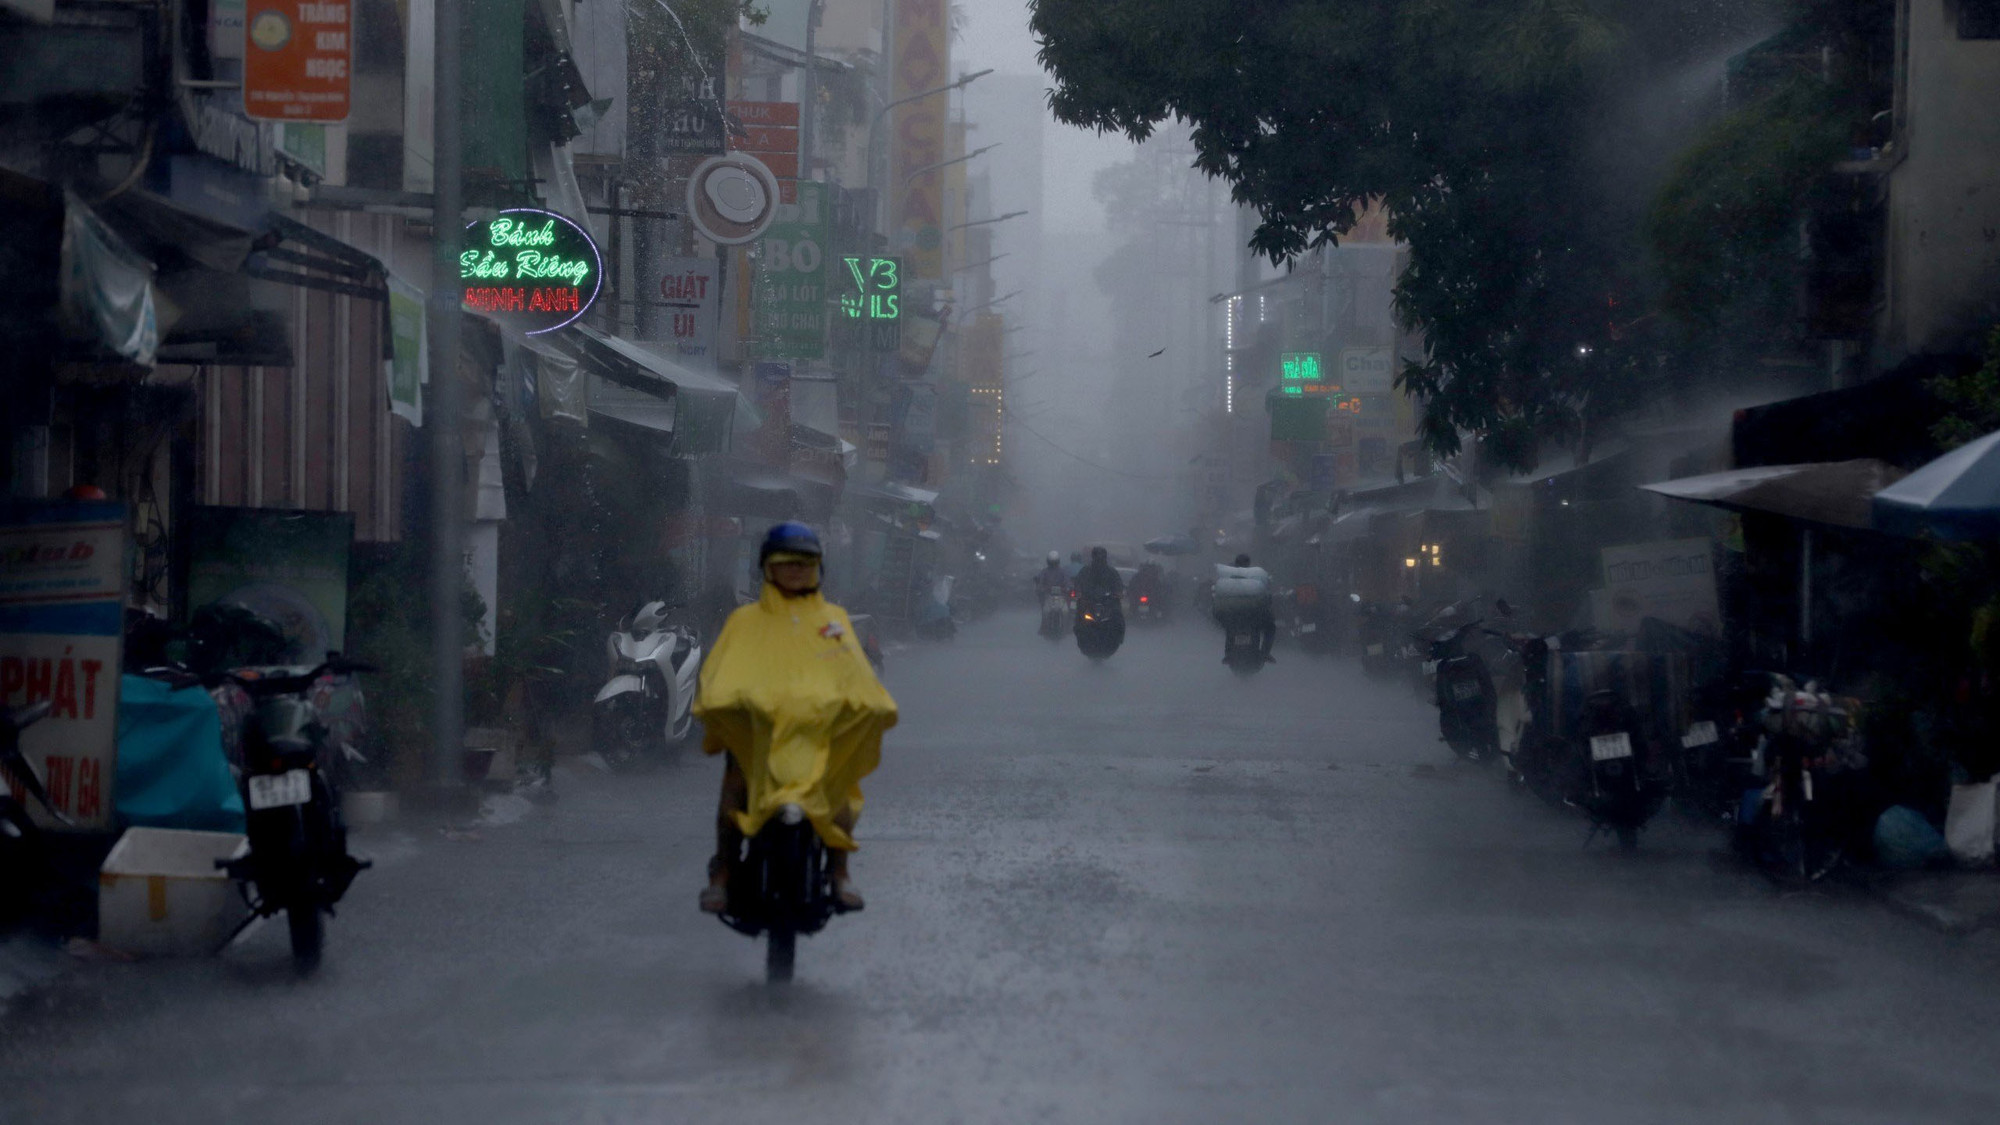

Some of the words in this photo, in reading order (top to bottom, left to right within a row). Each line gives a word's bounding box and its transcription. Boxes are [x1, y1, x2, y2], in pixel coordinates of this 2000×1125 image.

[315, 31, 346, 51] KIM
[305, 58, 347, 83] NGỌC
[490, 218, 555, 246] Bánh
[764, 230, 822, 273] BÒ
[459, 250, 509, 278] Sầu
[516, 250, 588, 287] Riêng
[465, 287, 524, 312] MINH
[529, 287, 580, 312] ANH
[660, 270, 710, 303] GIẶT
[0, 645, 102, 721] PHÁT
[78, 756, 101, 819] GA
